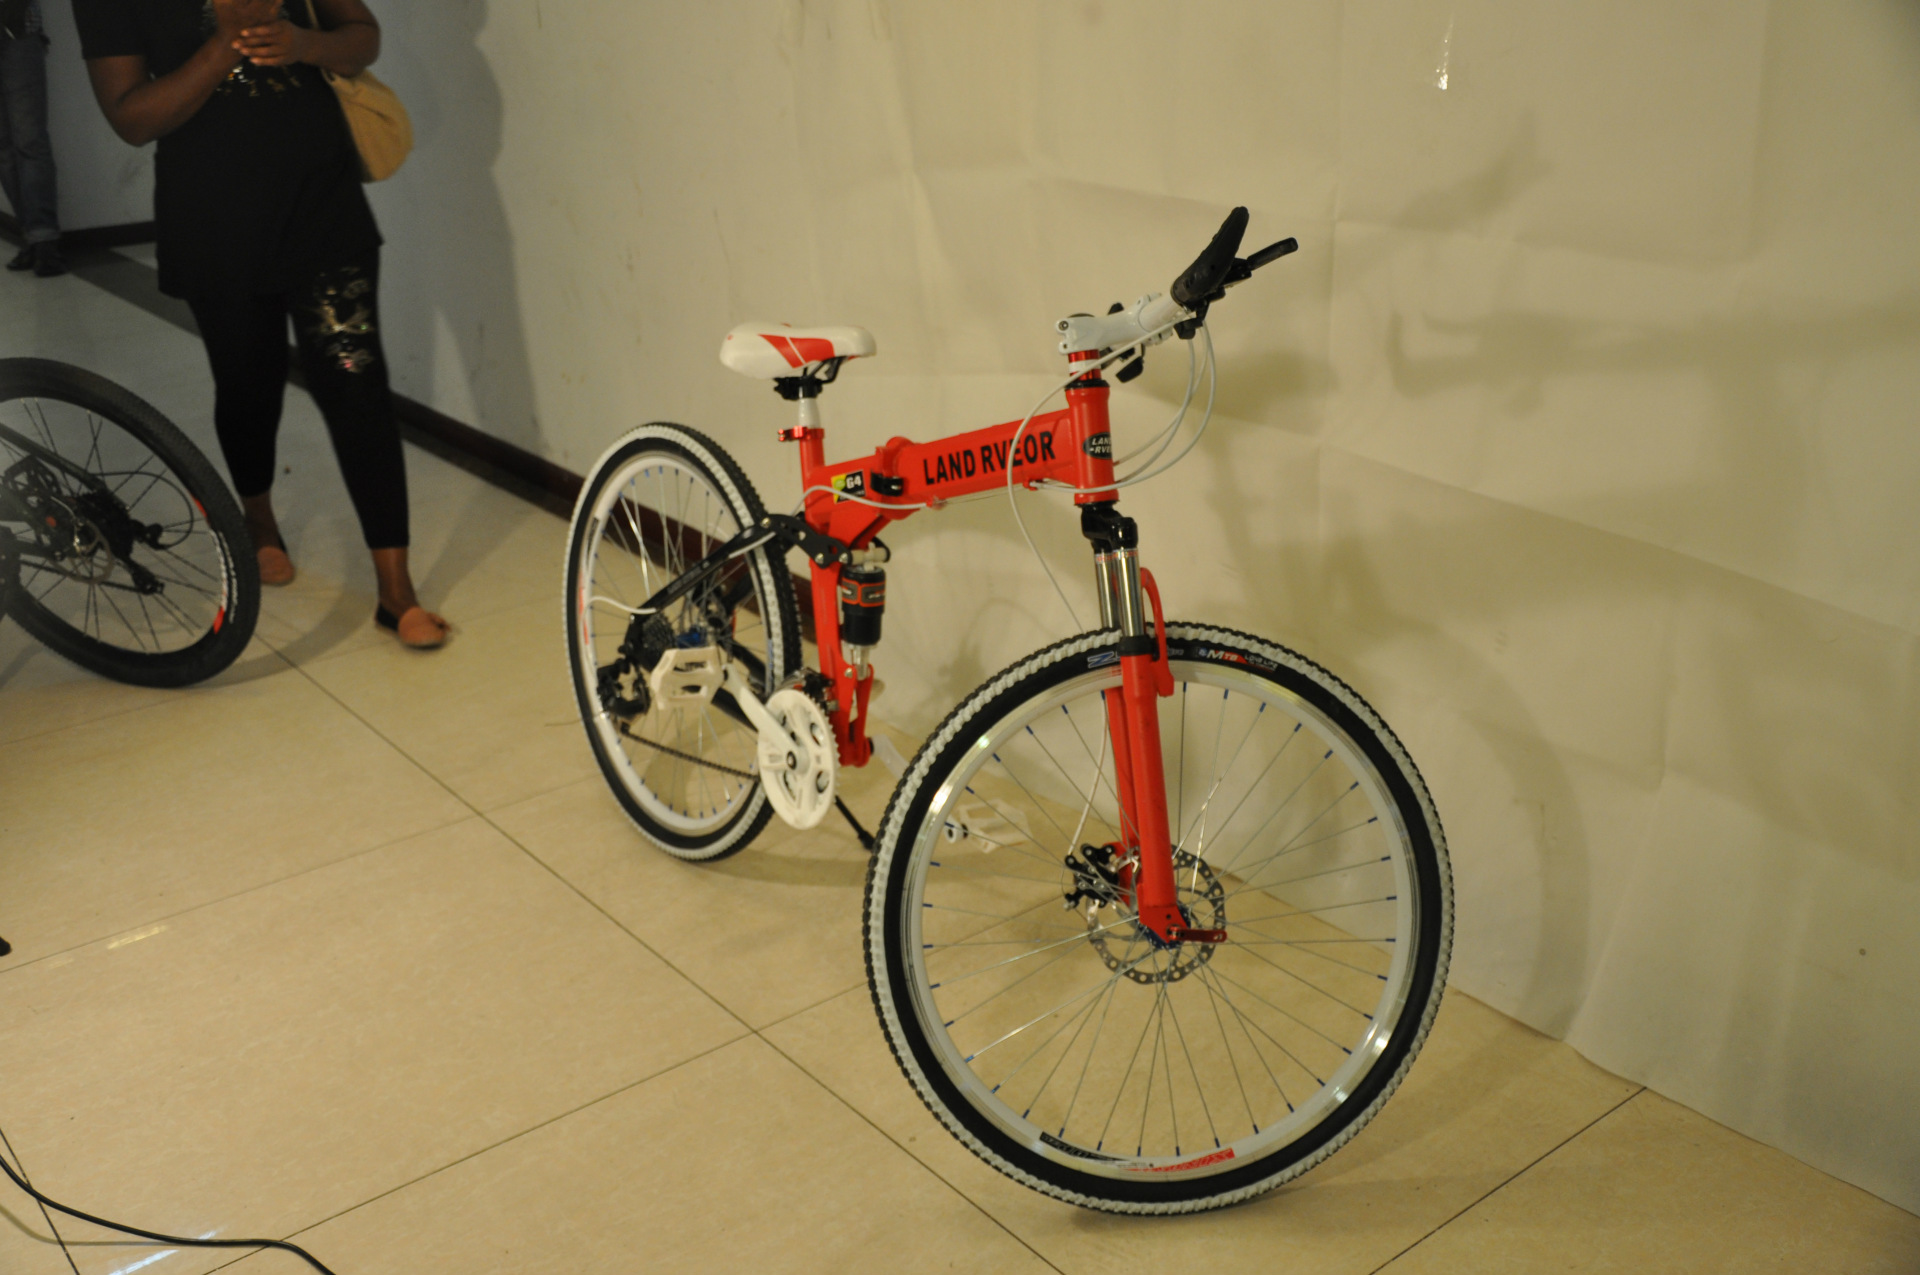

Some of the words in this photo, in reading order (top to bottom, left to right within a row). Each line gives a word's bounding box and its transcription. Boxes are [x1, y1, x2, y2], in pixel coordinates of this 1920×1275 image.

[1091, 437, 1110, 446] LAN
[922, 448, 976, 486] LAND
[846, 475, 862, 489] G4
